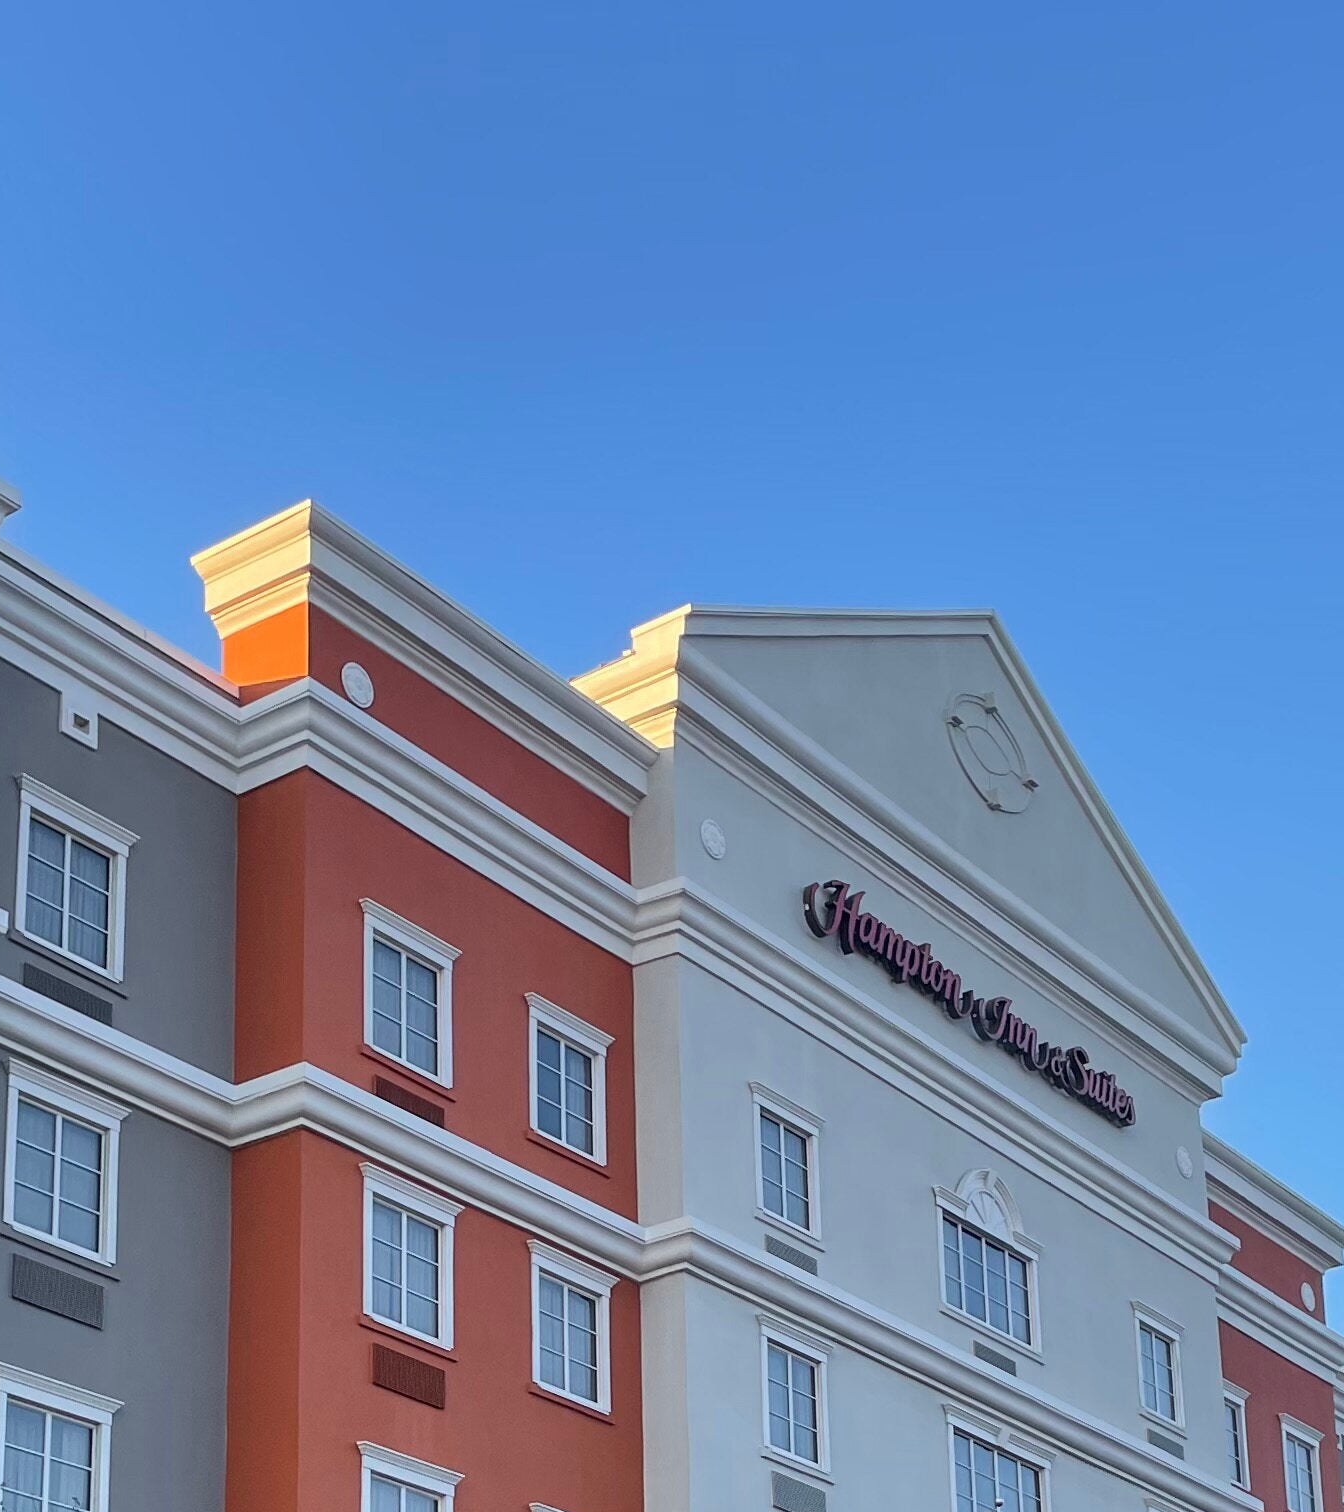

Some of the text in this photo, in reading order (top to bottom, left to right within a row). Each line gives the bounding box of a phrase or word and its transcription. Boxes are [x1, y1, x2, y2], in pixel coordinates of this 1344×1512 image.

[803, 880, 974, 1019] Hampton
[970, 996, 1050, 1072] Inn
[1066, 1046, 1136, 1128] Suites
